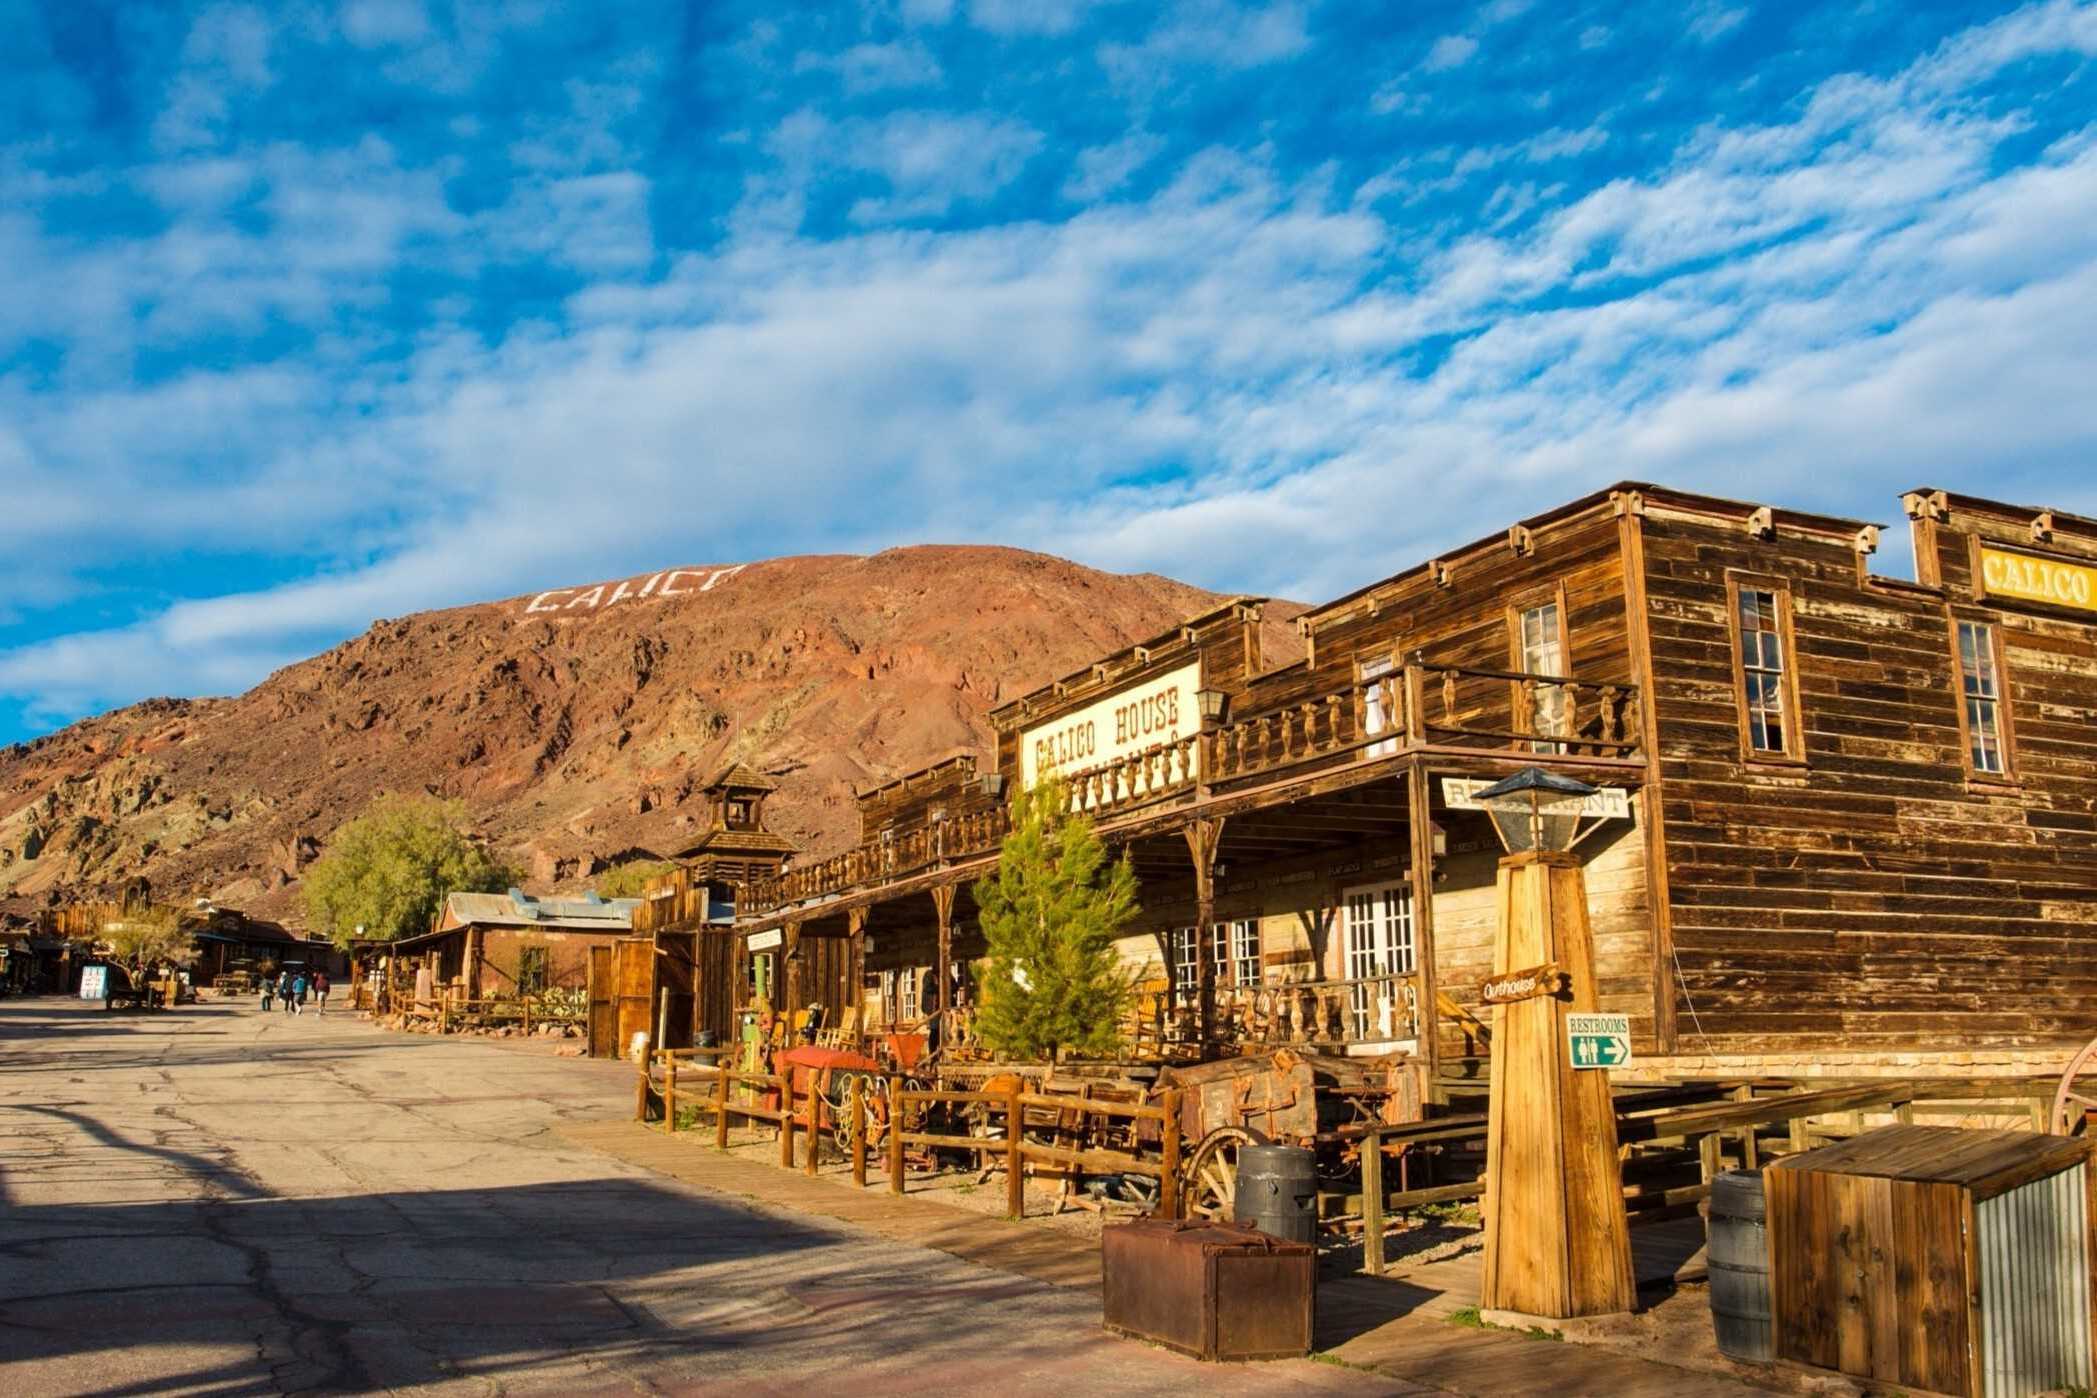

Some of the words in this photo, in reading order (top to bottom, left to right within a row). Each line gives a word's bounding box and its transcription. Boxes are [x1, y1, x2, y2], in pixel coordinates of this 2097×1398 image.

[1983, 555, 2090, 604] CALICO
[1035, 719, 1096, 773] CALICO
[1115, 686, 1178, 745] HOUSE
[1484, 976, 1537, 999] Outhouse
[1569, 1017, 1628, 1033] RESTROOMS
